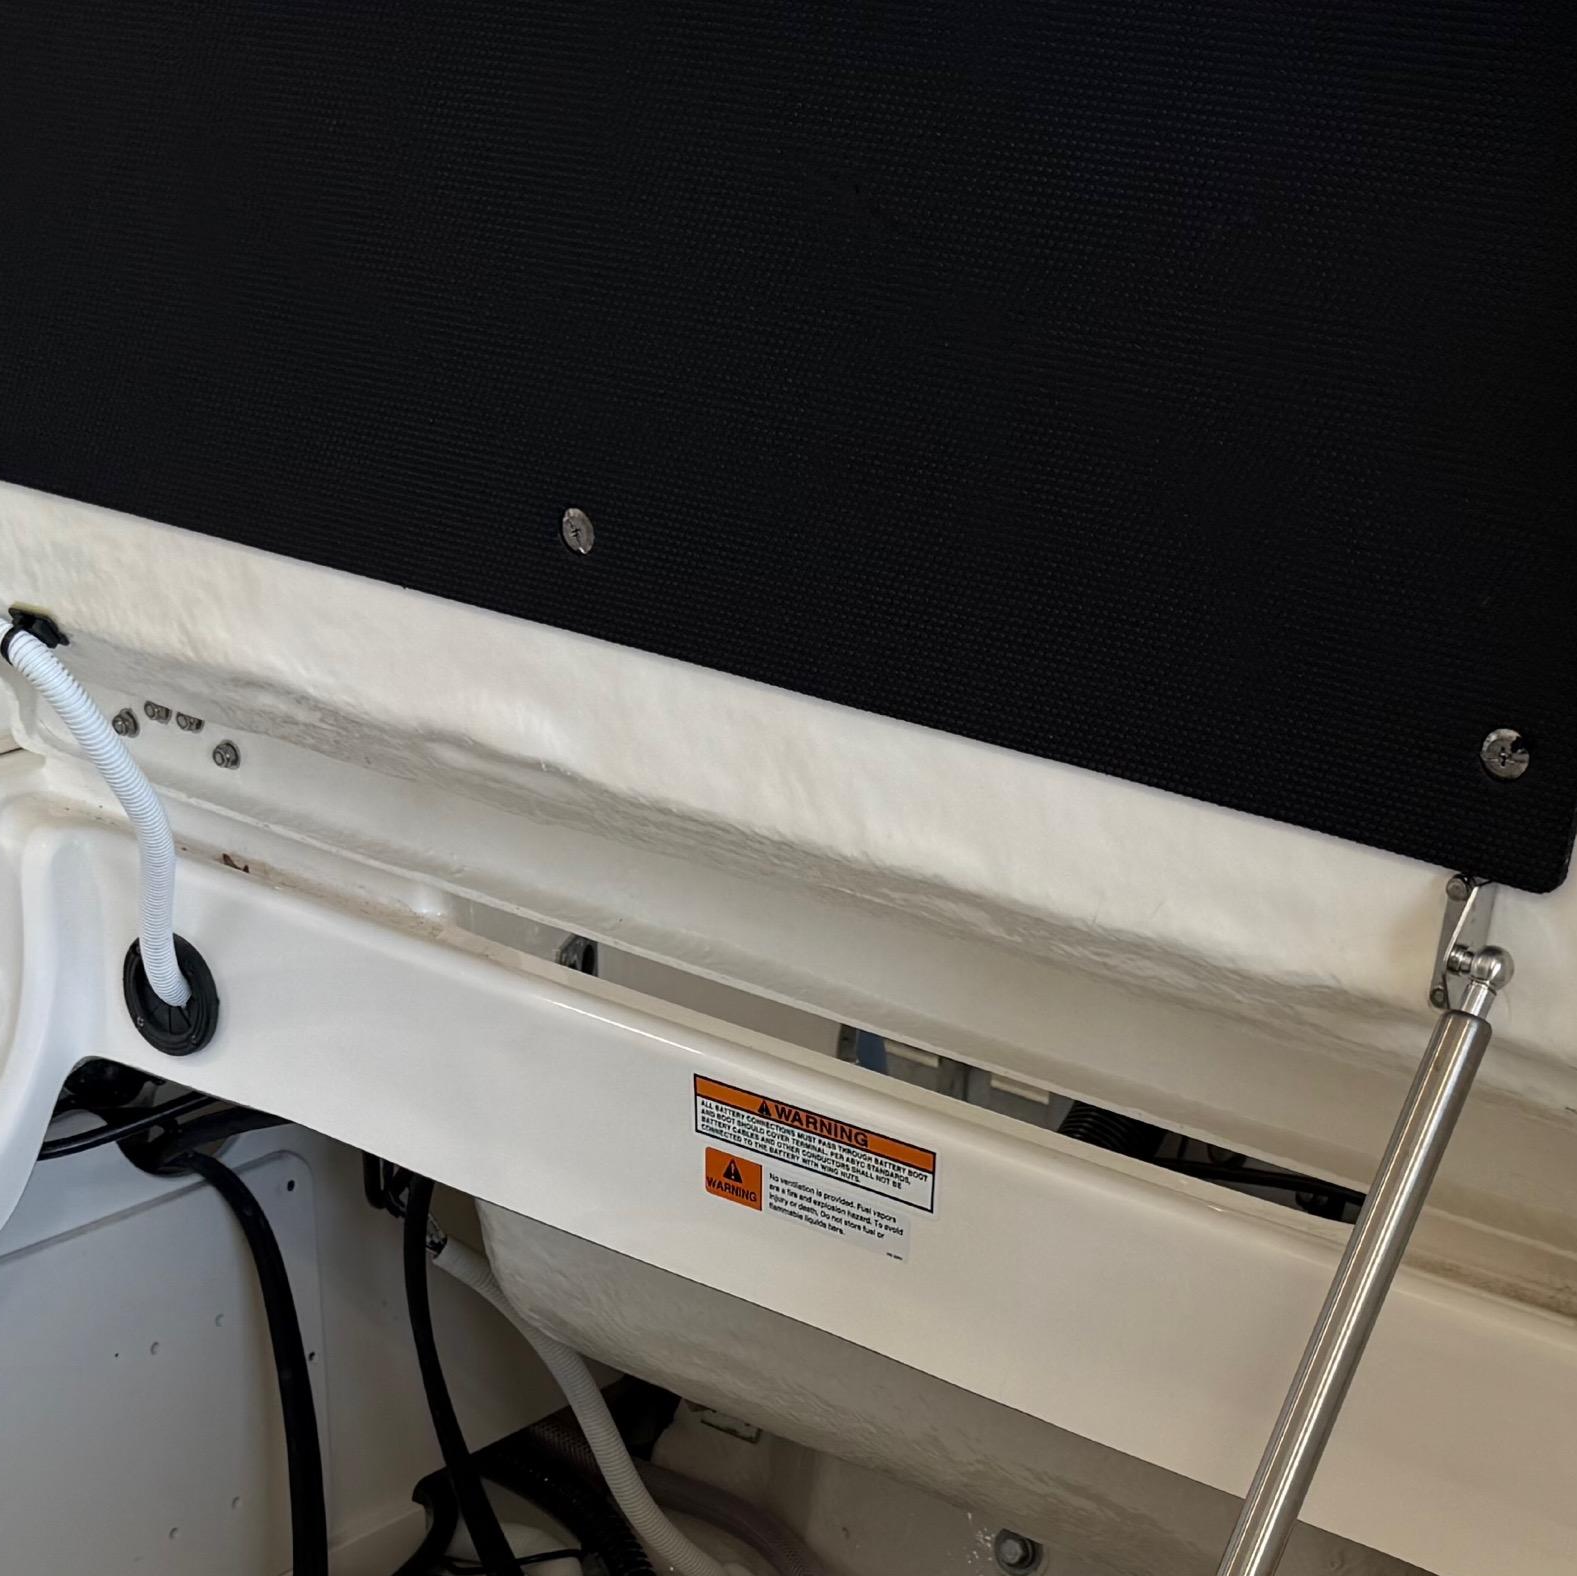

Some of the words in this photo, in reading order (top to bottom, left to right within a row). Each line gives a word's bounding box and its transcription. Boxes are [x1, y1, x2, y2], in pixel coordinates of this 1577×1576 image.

[701, 1108, 715, 1118] AND
[717, 1113, 734, 1125] BOOT
[737, 1120, 764, 1135] SHOULD
[766, 1130, 789, 1143] COVER
[830, 1151, 844, 1162] PER
[846, 1156, 864, 1169] ABYC
[701, 1100, 712, 1109] ALL
[715, 1104, 744, 1120] BATTERY
[747, 1115, 795, 1137] CONNECTIONS
[797, 1132, 815, 1144] MUST
[818, 1139, 835, 1151] PASS
[838, 1145, 872, 1163] THROUGH
[874, 1157, 906, 1174] BATTERY
[907, 1168, 927, 1181] BOOT
[701, 1123, 741, 1142] CONNECTED
[743, 1137, 752, 1146] TO
[754, 1141, 768, 1151] THE
[769, 1146, 799, 1162] BATTERY
[802, 1157, 818, 1169] WITH
[820, 1164, 837, 1175] WING
[774, 1104, 869, 1148] WARNING
[701, 1115, 730, 1131] BATTERY
[733, 1126, 759, 1140] CABLES
[761, 1136, 774, 1146] AND
[777, 1141, 800, 1154] OTHER
[802, 1149, 850, 1171] CONDUCTORS
[851, 1166, 873, 1179] SHALL
[875, 1174, 889, 1185] NOT
[892, 1180, 901, 1189] BE
[705, 1176, 757, 1202] WARNING
[769, 1172, 778, 1182] No
[780, 1176, 814, 1194] ventilation
[816, 1189, 822, 1197] is
[823, 1191, 855, 1209] provided.
[856, 1203, 871, 1214] Fuel
[872, 1210, 896, 1223] vapors
[769, 1184, 779, 1192] are
[786, 1188, 797, 1198] fire
[799, 1193, 811, 1203] and
[812, 1198, 845, 1216] explosion
[873, 1219, 882, 1228] To
[884, 1223, 903, 1235] avoid
[769, 1202, 802, 1220] flammable
[804, 1214, 826, 1228] liquids
[769, 1192, 787, 1206] injury
[789, 1200, 797, 1208] or
[820, 1210, 830, 1219] Do
[831, 1214, 841, 1223] not
[844, 1220, 860, 1230] store
[862, 1225, 875, 1235] fuel
[876, 1231, 884, 1239] or
